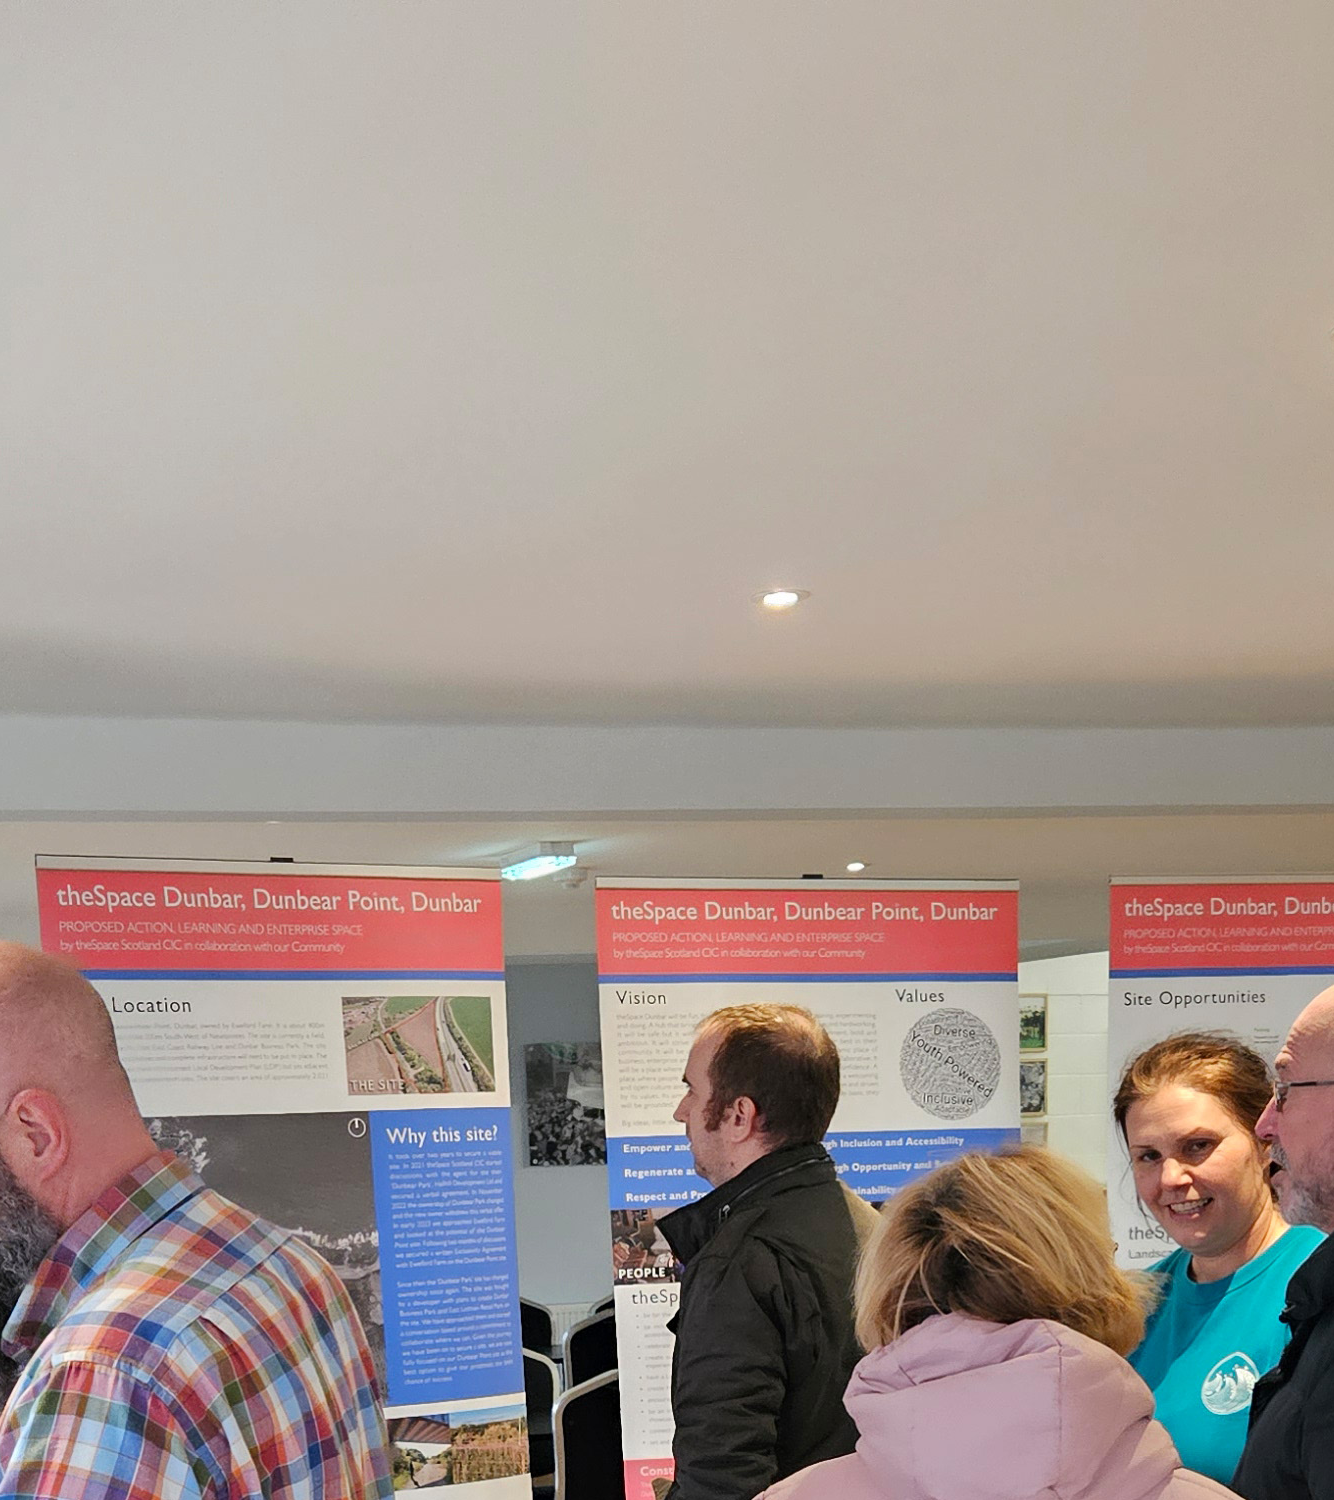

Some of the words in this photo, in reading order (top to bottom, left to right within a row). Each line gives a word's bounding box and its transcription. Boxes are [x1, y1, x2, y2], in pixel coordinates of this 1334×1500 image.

[56, 884, 156, 913] theSpace
[163, 886, 246, 911] Dunbar,
[253, 888, 341, 911] Dunbear
[348, 890, 405, 914] Point,
[411, 892, 481, 912] Dunbar
[611, 901, 698, 924] theSpace
[704, 901, 778, 922] Dunbar,
[785, 902, 864, 922] Dunbear
[872, 902, 924, 922] Point,
[931, 902, 998, 921] Dunbar
[1125, 898, 1204, 921] theSpace
[1210, 898, 1278, 917] Dunbar,
[615, 990, 667, 1005] Vision
[895, 989, 945, 1003] Values
[1124, 992, 1153, 1006] Site
[1159, 990, 1266, 1009] Opportunities
[112, 997, 192, 1014] Location
[933, 1024, 976, 1038] Diverse
[909, 1028, 942, 1060] Youth
[942, 1052, 993, 1098] Powered
[350, 1079, 375, 1092] THE
[377, 1079, 406, 1091] SITE
[922, 1091, 973, 1106] Inclusive
[386, 1126, 427, 1147] Why
[432, 1126, 461, 1143] this
[466, 1125, 499, 1142] site?
[840, 1138, 882, 1148] Inclusion
[885, 1137, 903, 1147] and
[905, 1135, 964, 1149] Accessibility
[623, 1142, 669, 1156] Empower
[624, 1166, 685, 1178] Regenerate
[851, 1161, 911, 1174] Opportunity
[913, 1161, 931, 1170] and
[626, 1190, 666, 1204] Respect
[668, 1190, 688, 1201] and
[618, 1267, 666, 1280] PEOPLE
[631, 1289, 678, 1308] theSp
